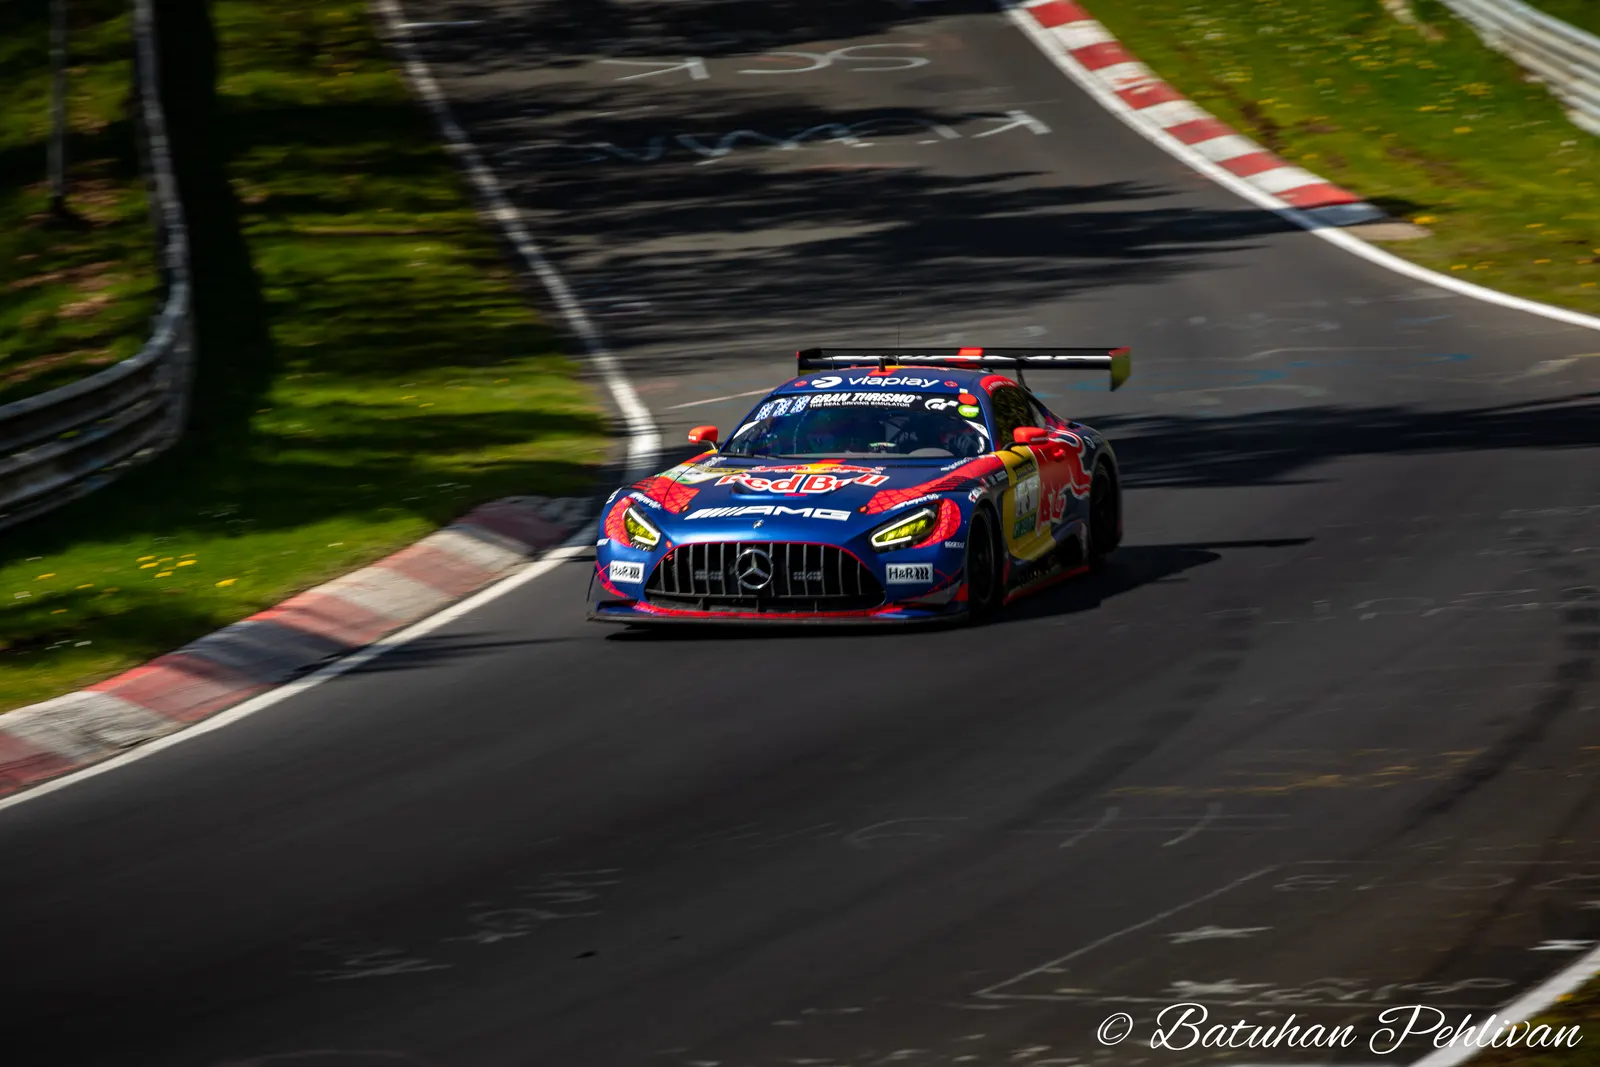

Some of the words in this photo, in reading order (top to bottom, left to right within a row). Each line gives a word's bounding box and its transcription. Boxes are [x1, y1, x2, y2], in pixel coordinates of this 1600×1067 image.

[848, 376, 940, 388] viaplay
[810, 393, 849, 404] GRAN
[734, 505, 852, 522] AMG
[888, 567, 914, 580] H&R
